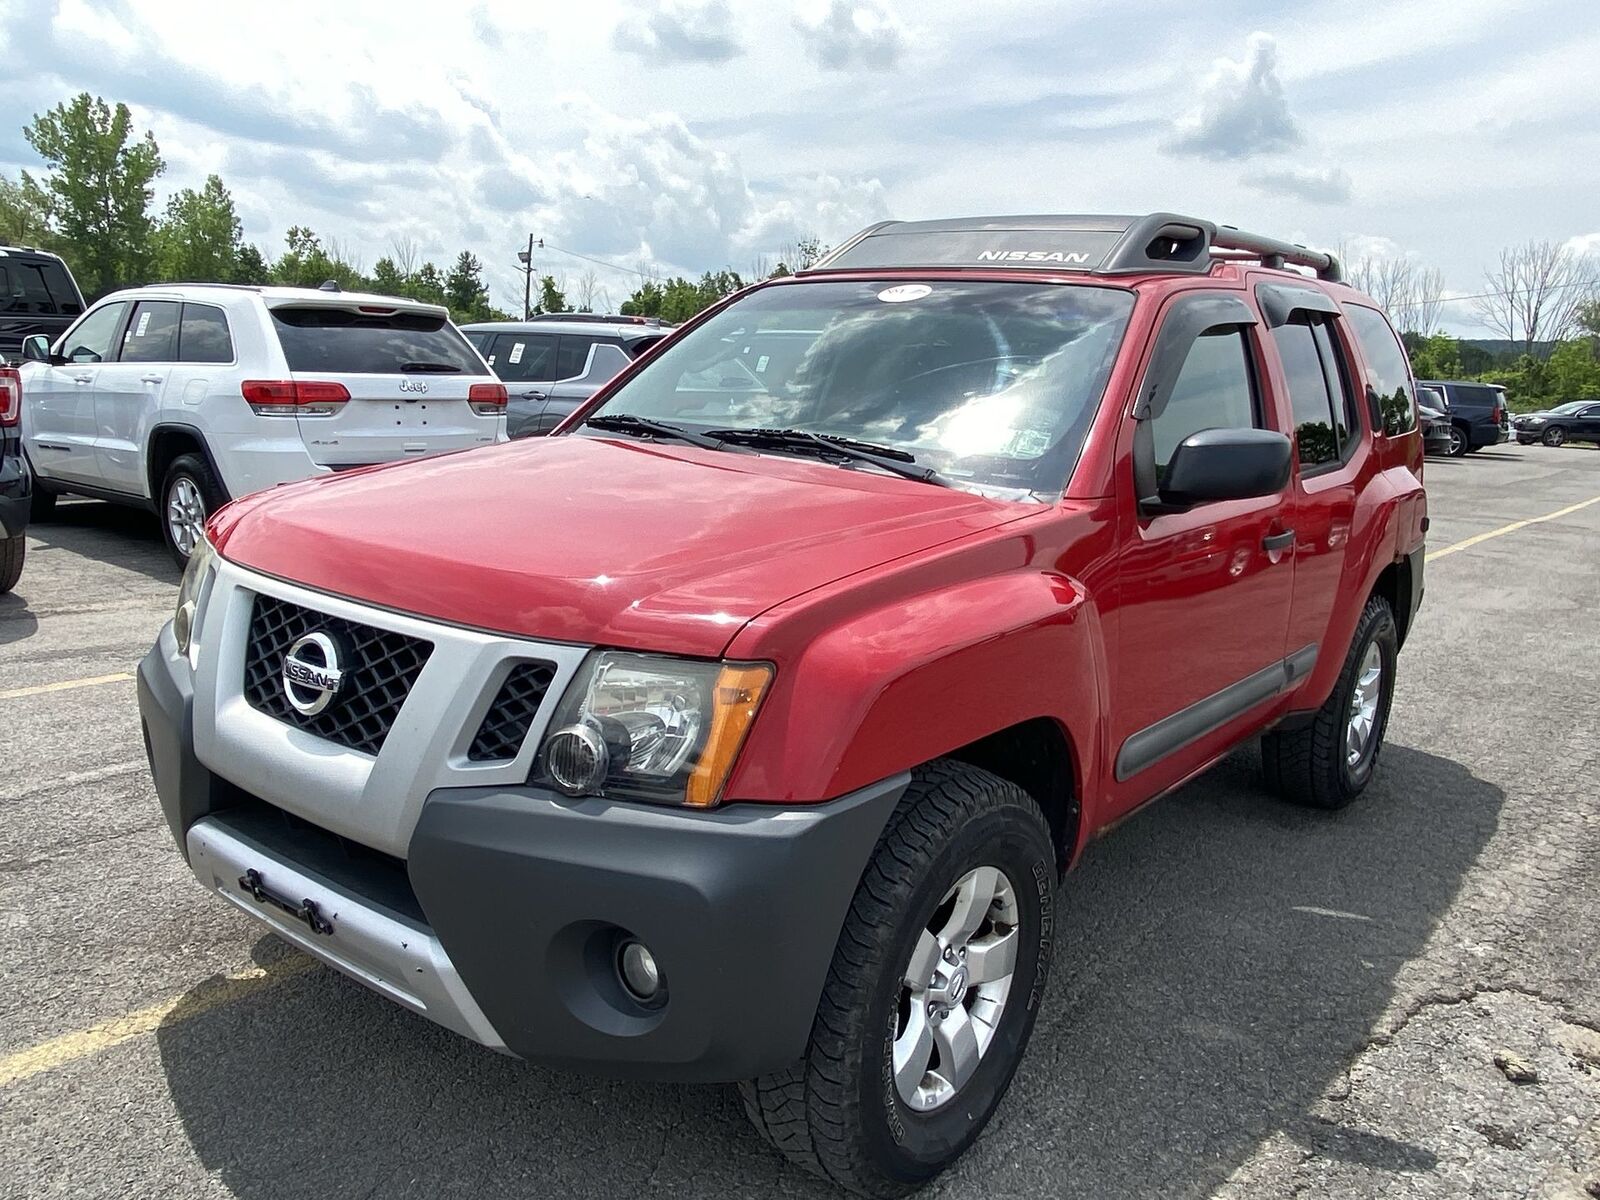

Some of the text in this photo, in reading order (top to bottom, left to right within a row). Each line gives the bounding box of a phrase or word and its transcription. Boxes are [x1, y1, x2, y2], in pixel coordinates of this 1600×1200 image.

[977, 250, 1090, 263] NISSAN
[400, 380, 428, 394] Jeep
[1026, 858, 1054, 1011] GENERAL
